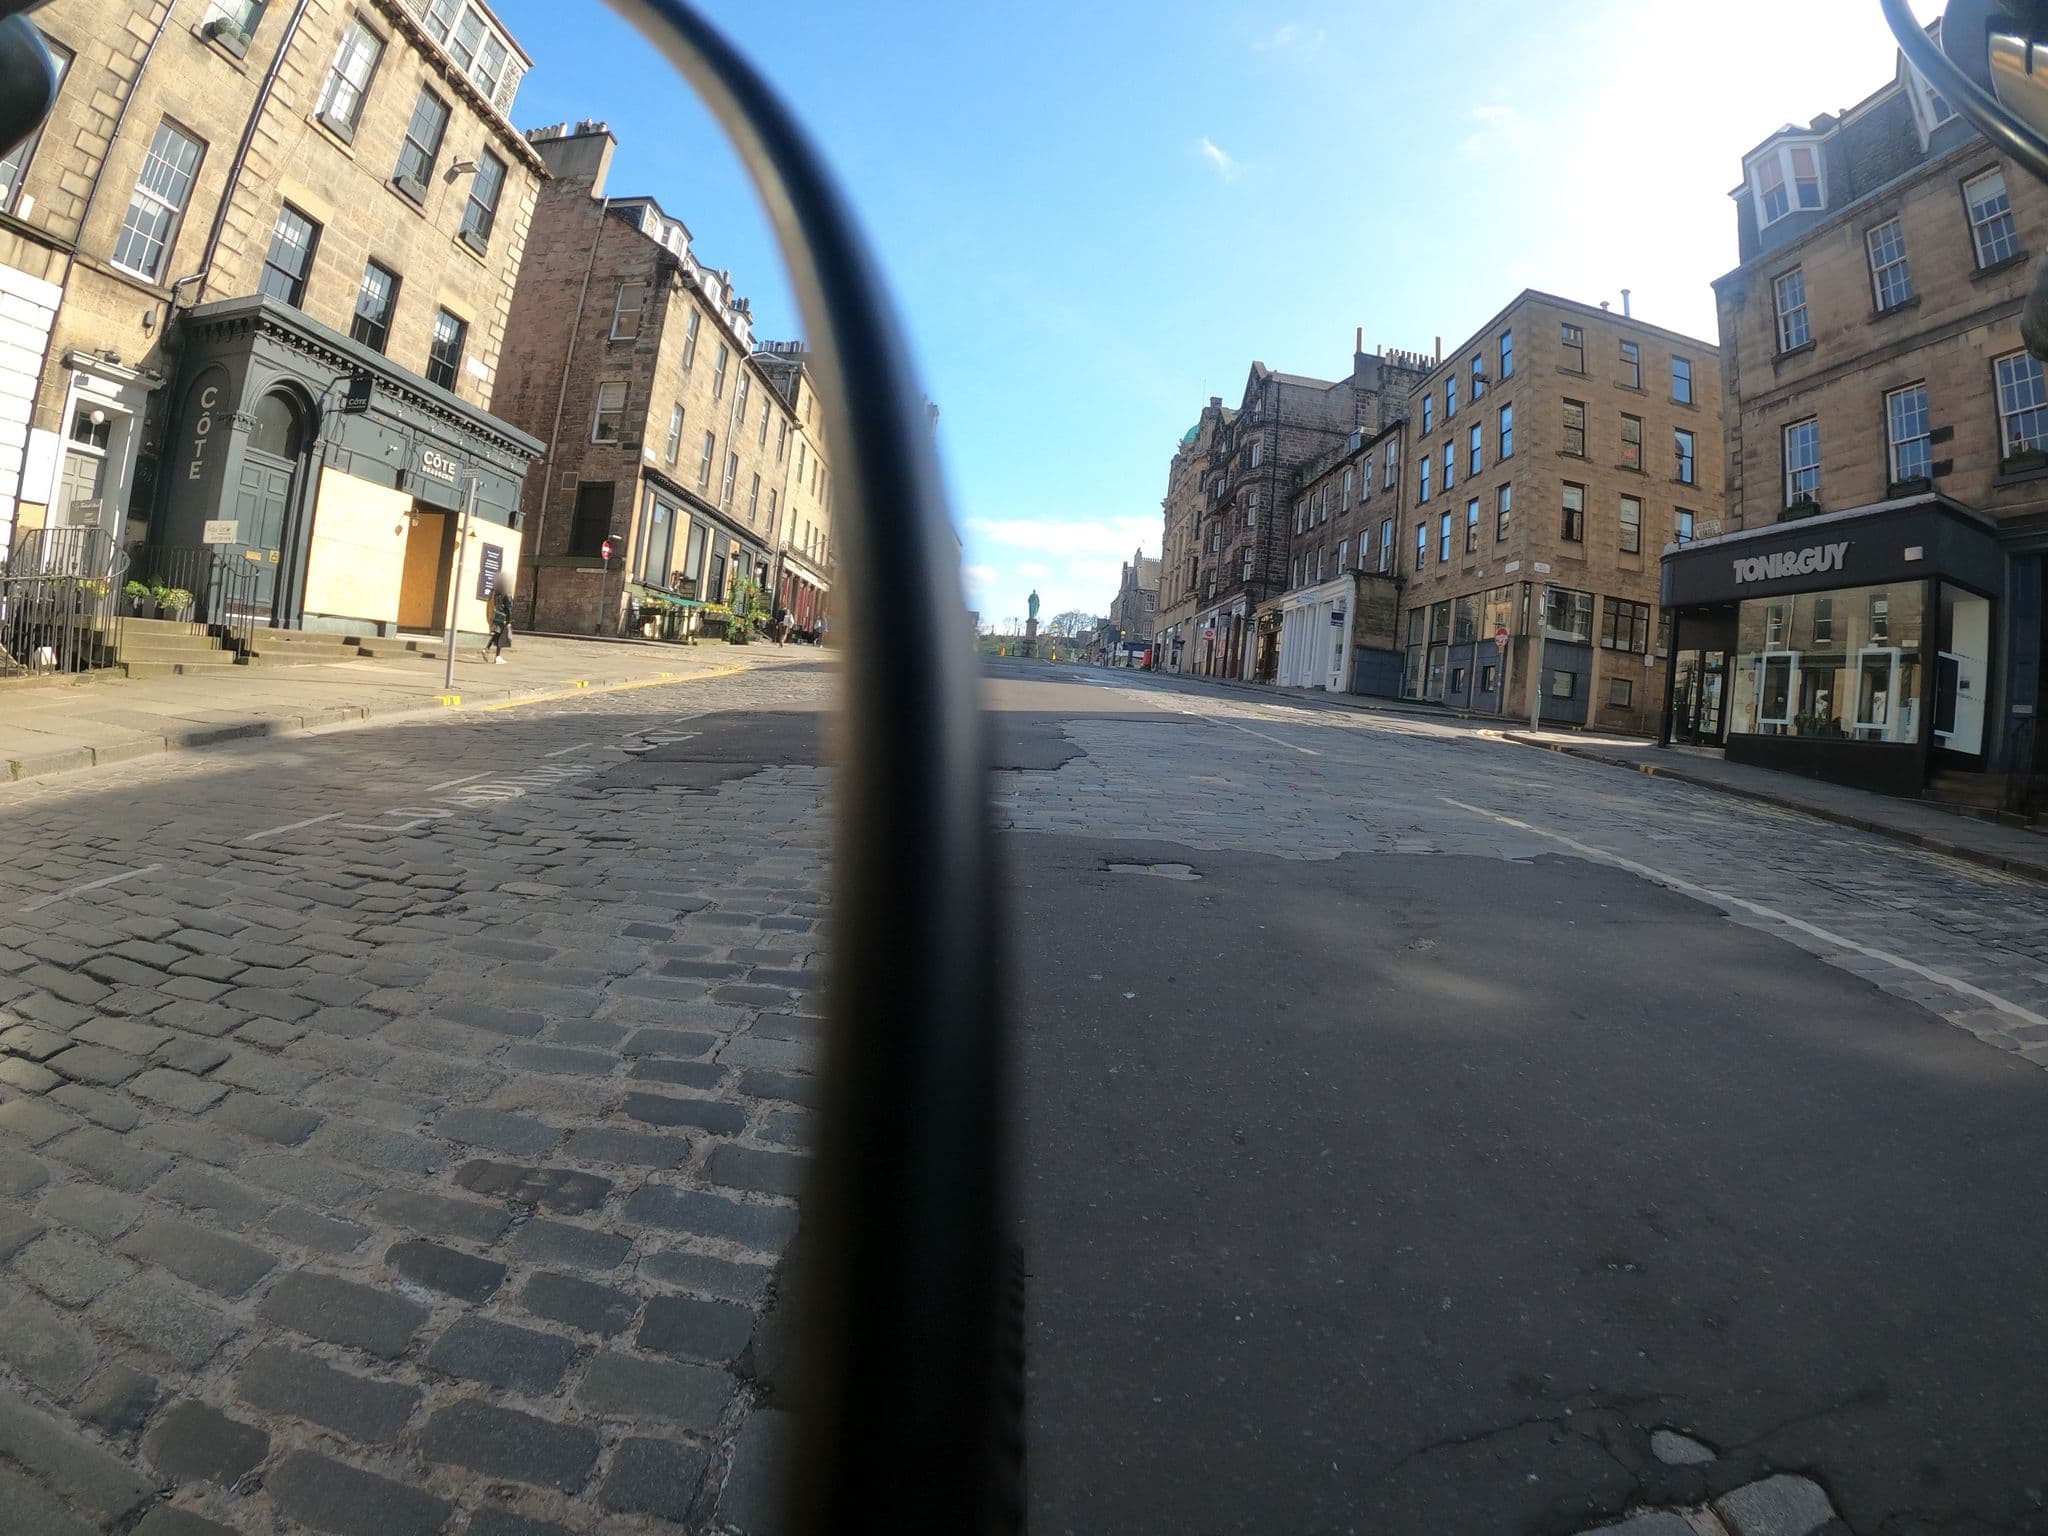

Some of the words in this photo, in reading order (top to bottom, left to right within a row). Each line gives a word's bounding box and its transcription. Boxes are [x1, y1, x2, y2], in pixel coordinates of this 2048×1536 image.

[189, 386, 219, 480] CÔTE
[423, 450, 457, 475] CÔTE
[1733, 541, 1849, 584] TONI&GUY
